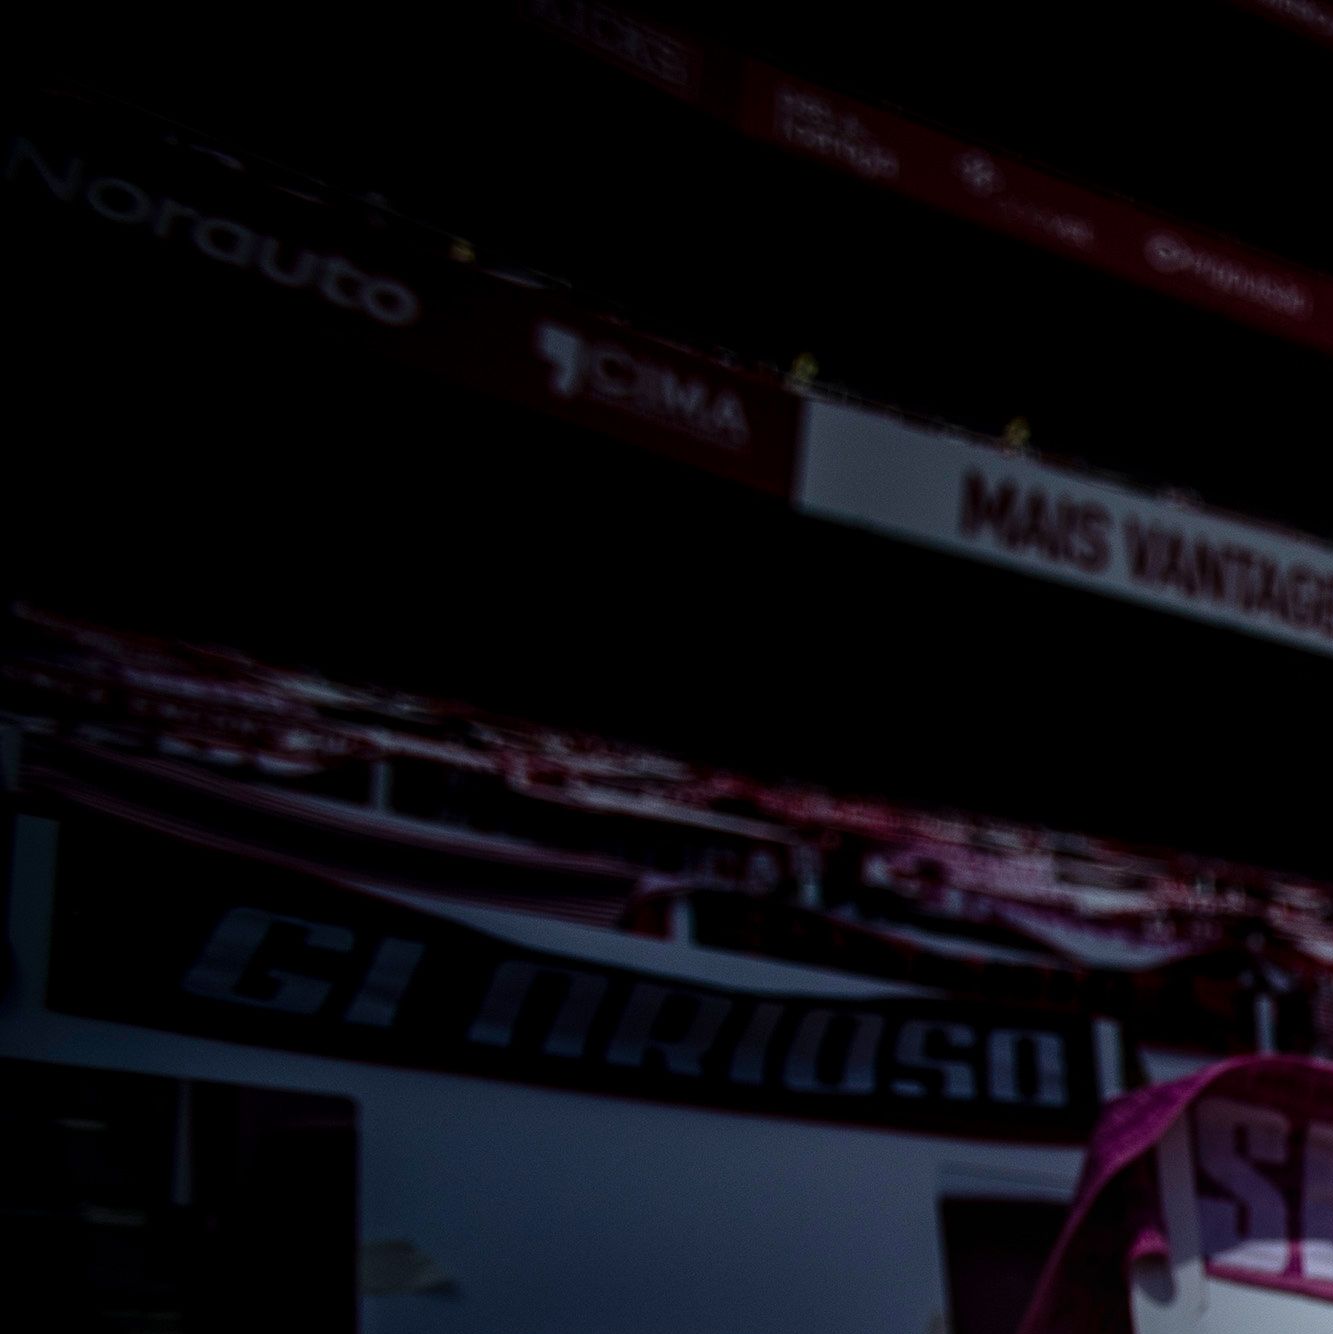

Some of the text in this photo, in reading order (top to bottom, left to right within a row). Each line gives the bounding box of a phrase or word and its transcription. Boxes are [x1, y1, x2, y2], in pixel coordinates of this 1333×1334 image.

[3, 135, 421, 328] Norauto
[592, 340, 751, 450] CIMA
[960, 467, 1114, 575] MAIS
